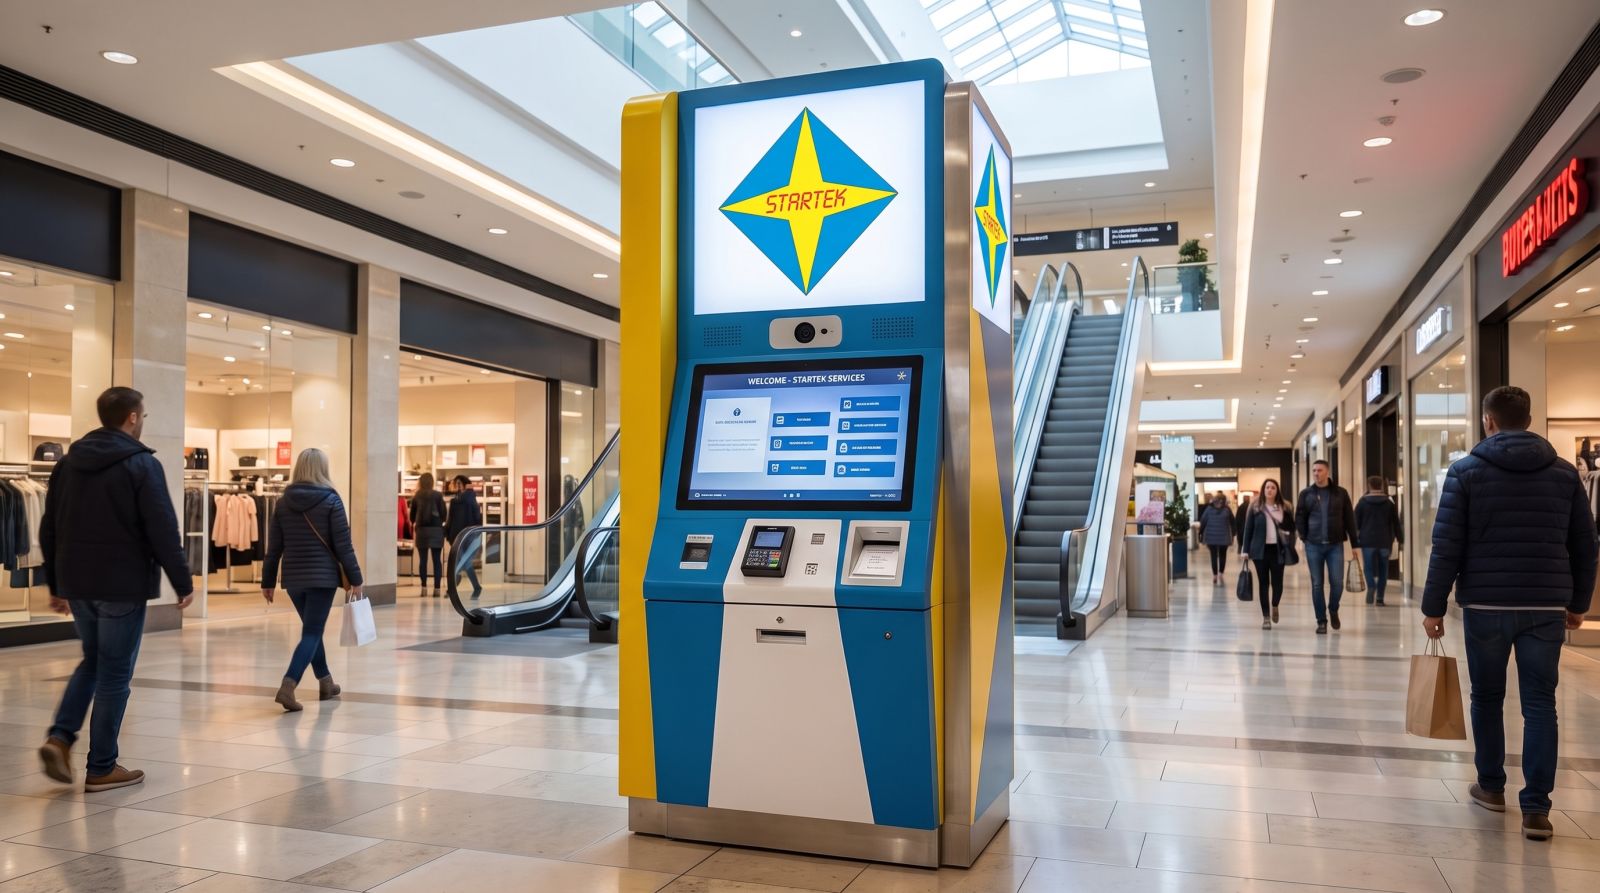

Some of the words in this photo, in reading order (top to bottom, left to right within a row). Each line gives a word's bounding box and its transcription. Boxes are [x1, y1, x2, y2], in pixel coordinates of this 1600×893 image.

[765, 188, 848, 214] STARTEK
[748, 376, 787, 385] WELCOME
[792, 375, 827, 384] STARTEK
[827, 373, 866, 383] SERVICES
